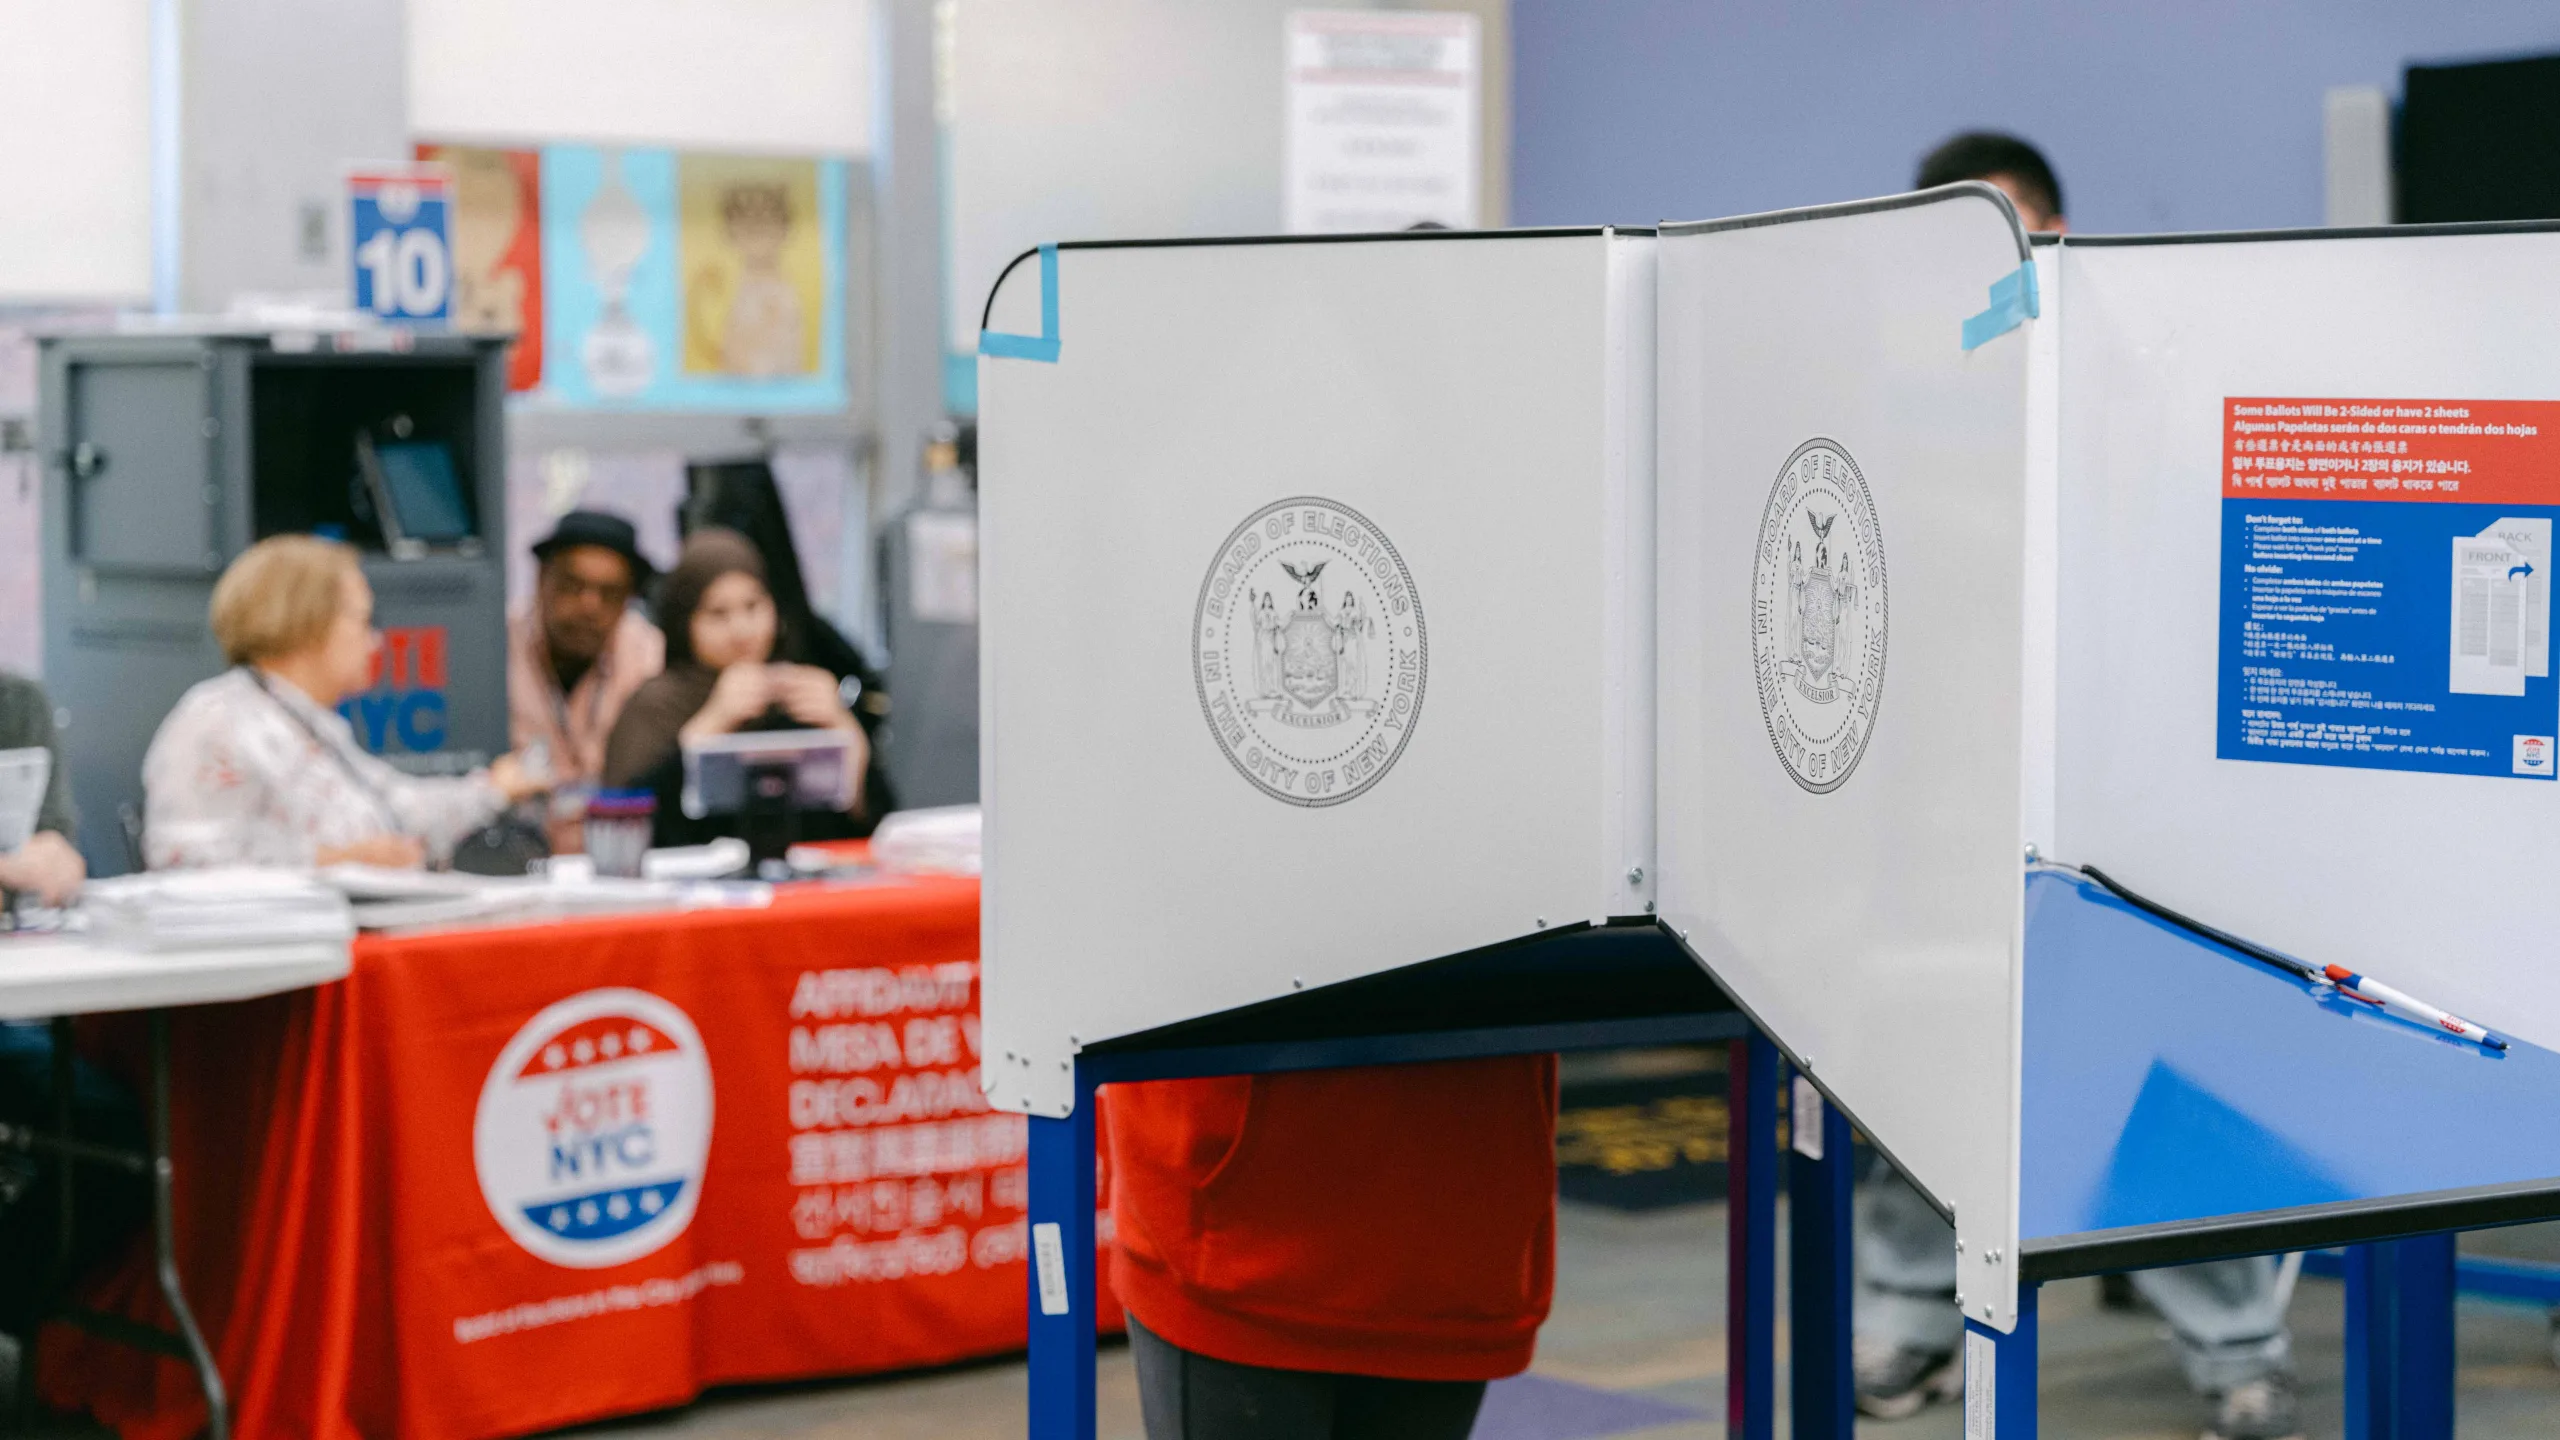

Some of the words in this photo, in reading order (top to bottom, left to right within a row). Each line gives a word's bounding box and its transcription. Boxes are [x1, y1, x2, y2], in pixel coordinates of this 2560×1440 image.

[357, 228, 447, 317] 10
[2234, 404, 2263, 417] Some
[2266, 404, 2301, 417] Ballots
[2302, 405, 2322, 417] Will
[2324, 406, 2338, 417] Be
[2340, 406, 2380, 417] 2-Sided
[2382, 408, 2394, 417] or
[2396, 406, 2422, 418] have
[2425, 407, 2431, 417] 2
[2433, 407, 2469, 418] sheets
[2234, 421, 2276, 434] Algunas
[2278, 421, 2328, 435] Papeletas
[2330, 422, 2359, 433] serán
[2361, 423, 2375, 434] de
[2377, 423, 2397, 434] dos
[2399, 425, 2427, 434] caras
[2430, 426, 2437, 434] o
[2439, 424, 2482, 435] tendrán
[2484, 424, 2505, 435] dos
[2507, 425, 2537, 437] hojas
[2232, 457, 2252, 470] 일부
[2255, 457, 2305, 471] 투표용지는
[2308, 458, 2359, 472] 양면이거나
[2361, 458, 2389, 473] 2장의
[2391, 459, 2423, 473] 용지가
[2425, 460, 2472, 474] 있습니다.
[1761, 471, 1797, 565] BOARD
[1801, 454, 1819, 484] OF
[1823, 454, 1880, 588] ELECTIONS
[2498, 531, 2533, 543] BACK
[1205, 531, 1261, 619] BOARD
[1266, 512, 1295, 539] OF
[1303, 510, 1409, 616] ELECTIONS
[2468, 551, 2512, 563] FRONT
[1757, 599, 1767, 635] IN
[1760, 646, 1779, 713] THE
[1799, 681, 1835, 701] EXCELSIOR
[1857, 628, 1882, 720] YORK
[336, 690, 447, 753] YC
[1202, 651, 1221, 684] IN
[1212, 691, 1246, 749] THE
[1246, 746, 1299, 790] CITY
[1305, 770, 1335, 794] OF
[1341, 733, 1389, 785] NEW
[1384, 649, 1417, 732] YORK
[1280, 712, 1342, 726] EXCELSIOR
[1776, 714, 1806, 768] CITY
[1808, 752, 1827, 778] OF
[1831, 720, 1861, 775] NEW
[790, 1021, 901, 1073] MESA
[904, 1015, 960, 1066] DE
[549, 1124, 655, 1183] NYC
